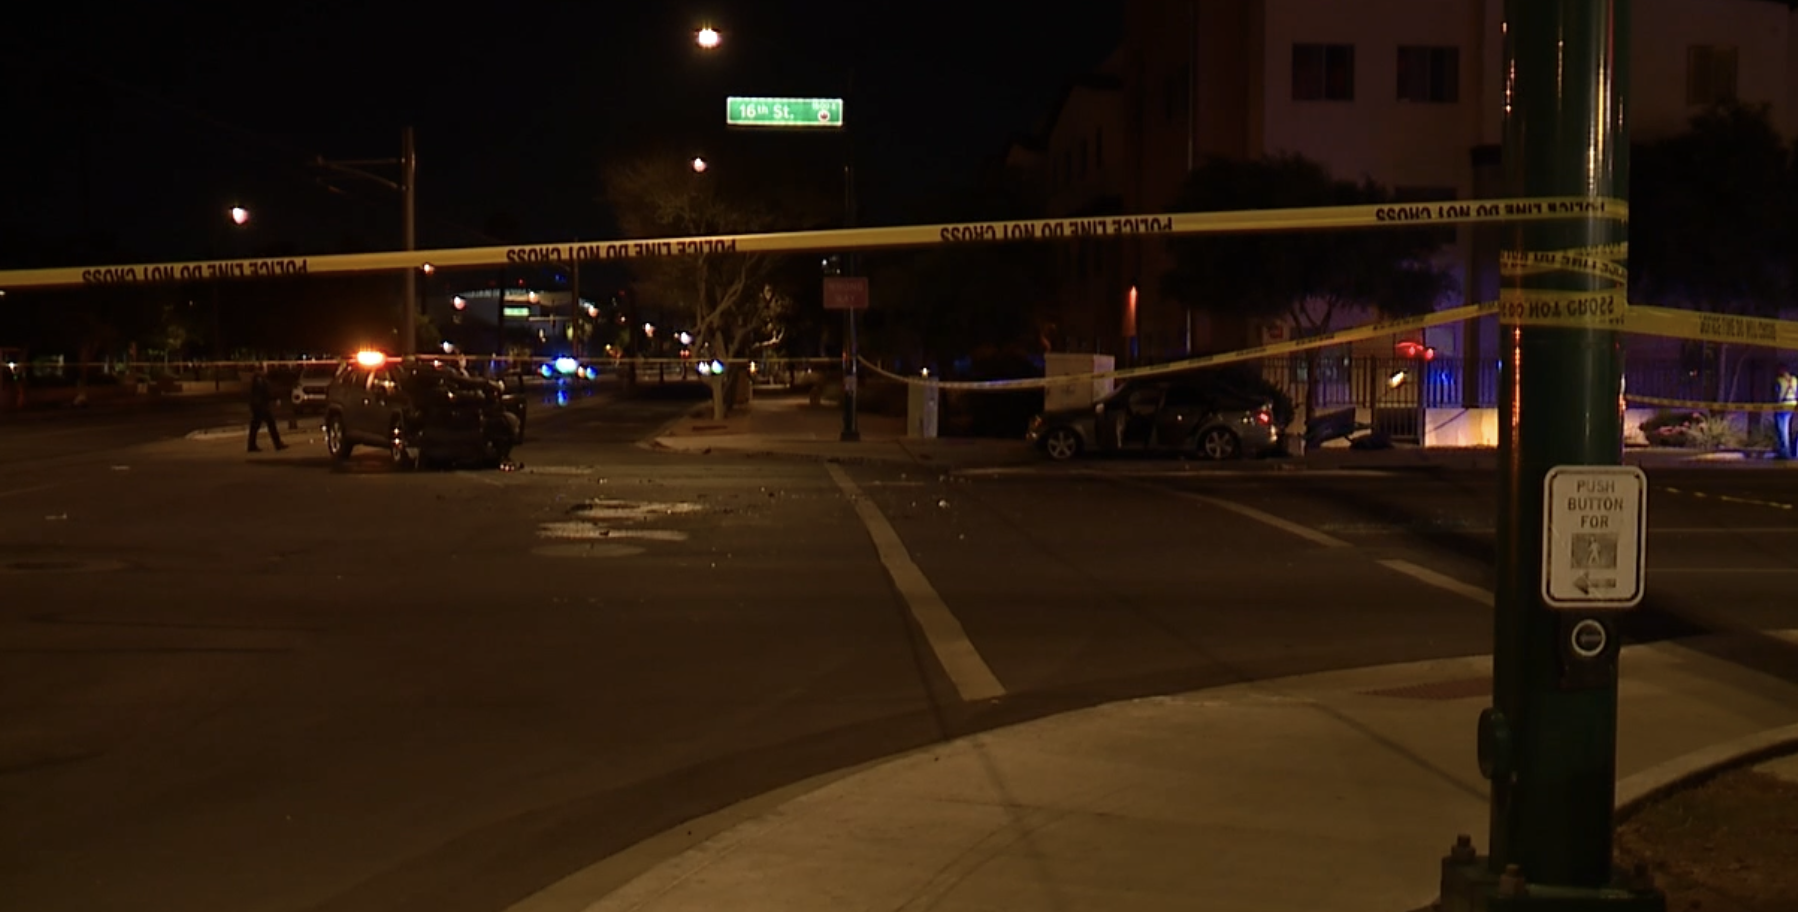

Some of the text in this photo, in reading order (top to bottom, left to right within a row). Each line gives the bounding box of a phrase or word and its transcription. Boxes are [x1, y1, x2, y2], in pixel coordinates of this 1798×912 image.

[740, 103, 769, 120] 16th
[773, 103, 795, 120] St.
[940, 217, 1173, 243] POLICE LINE DO NOT CROSS
[506, 239, 736, 264] POLICE LINE DO NOT CROSS
[82, 260, 307, 286] POLICE LINE DO NOT CROSS
[1577, 479, 1615, 493] PUSH
[1567, 496, 1624, 511] BUTTON
[1580, 514, 1609, 528] FOR
